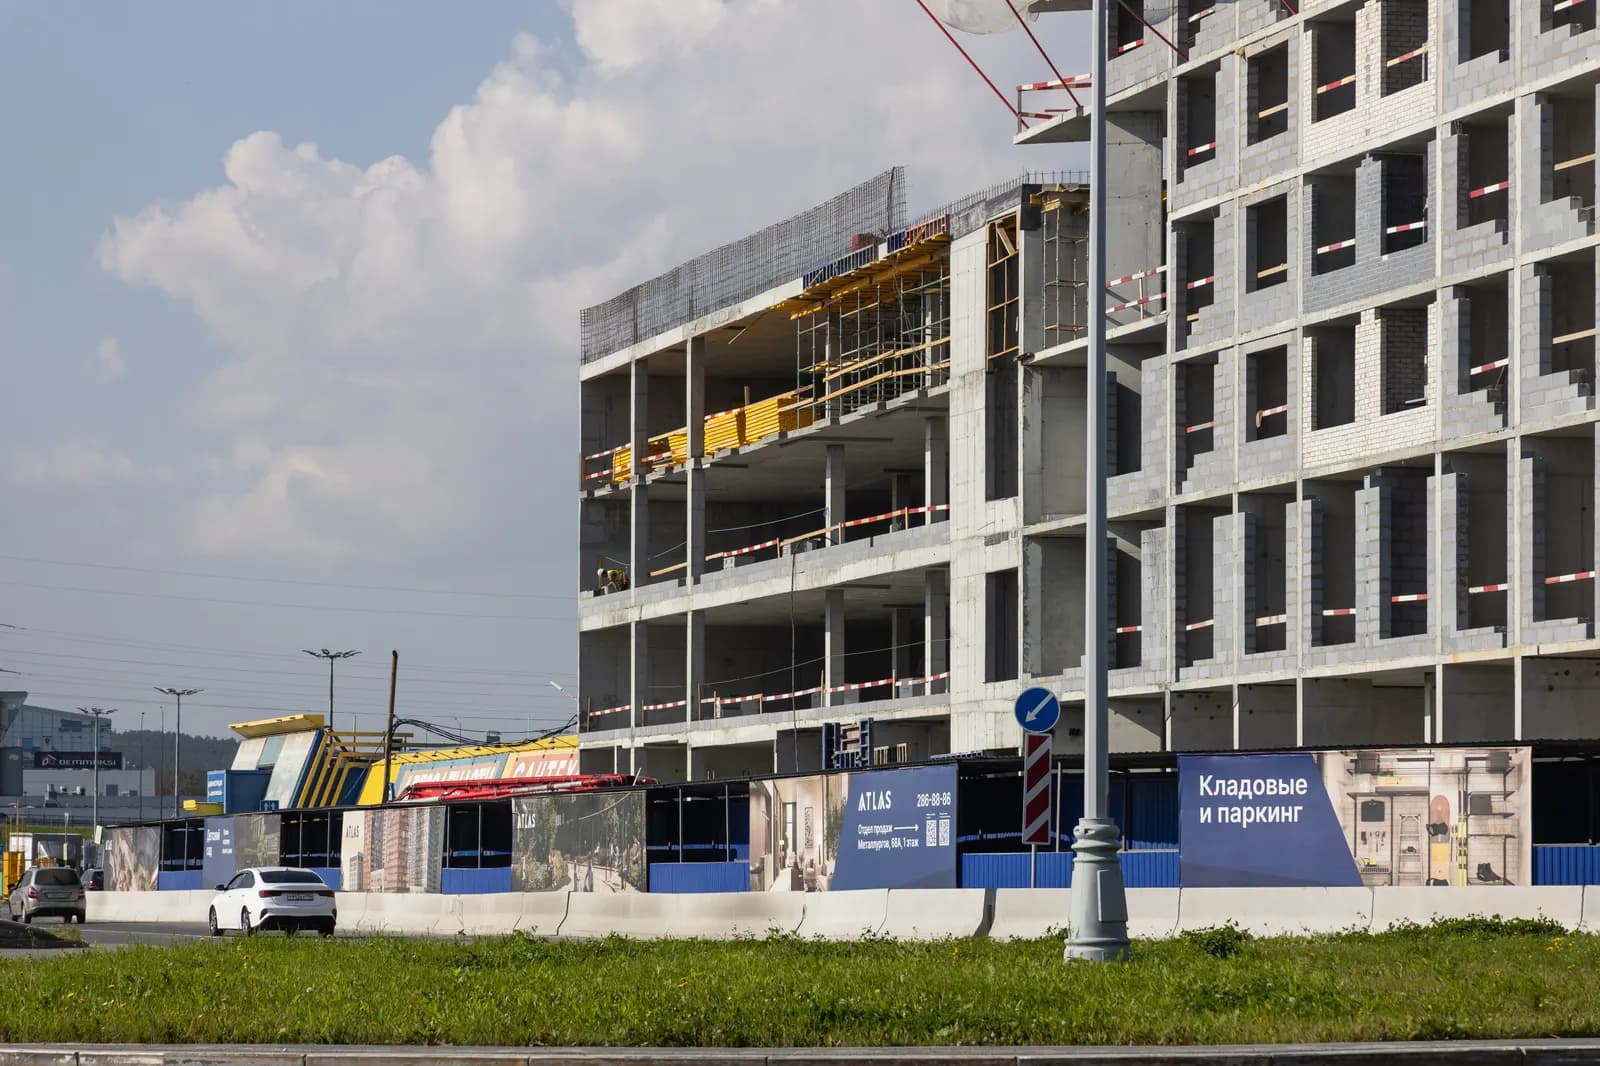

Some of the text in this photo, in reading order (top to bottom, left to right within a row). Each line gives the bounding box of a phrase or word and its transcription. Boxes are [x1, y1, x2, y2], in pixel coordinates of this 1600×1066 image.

[1199, 774, 1308, 800] Кладовые
[858, 789, 892, 811] ATLAS
[916, 792, 951, 808] 286-88-86
[517, 813, 536, 829] ATLAS
[1199, 806, 1303, 829] и паркинг
[874, 824, 893, 836] продаж
